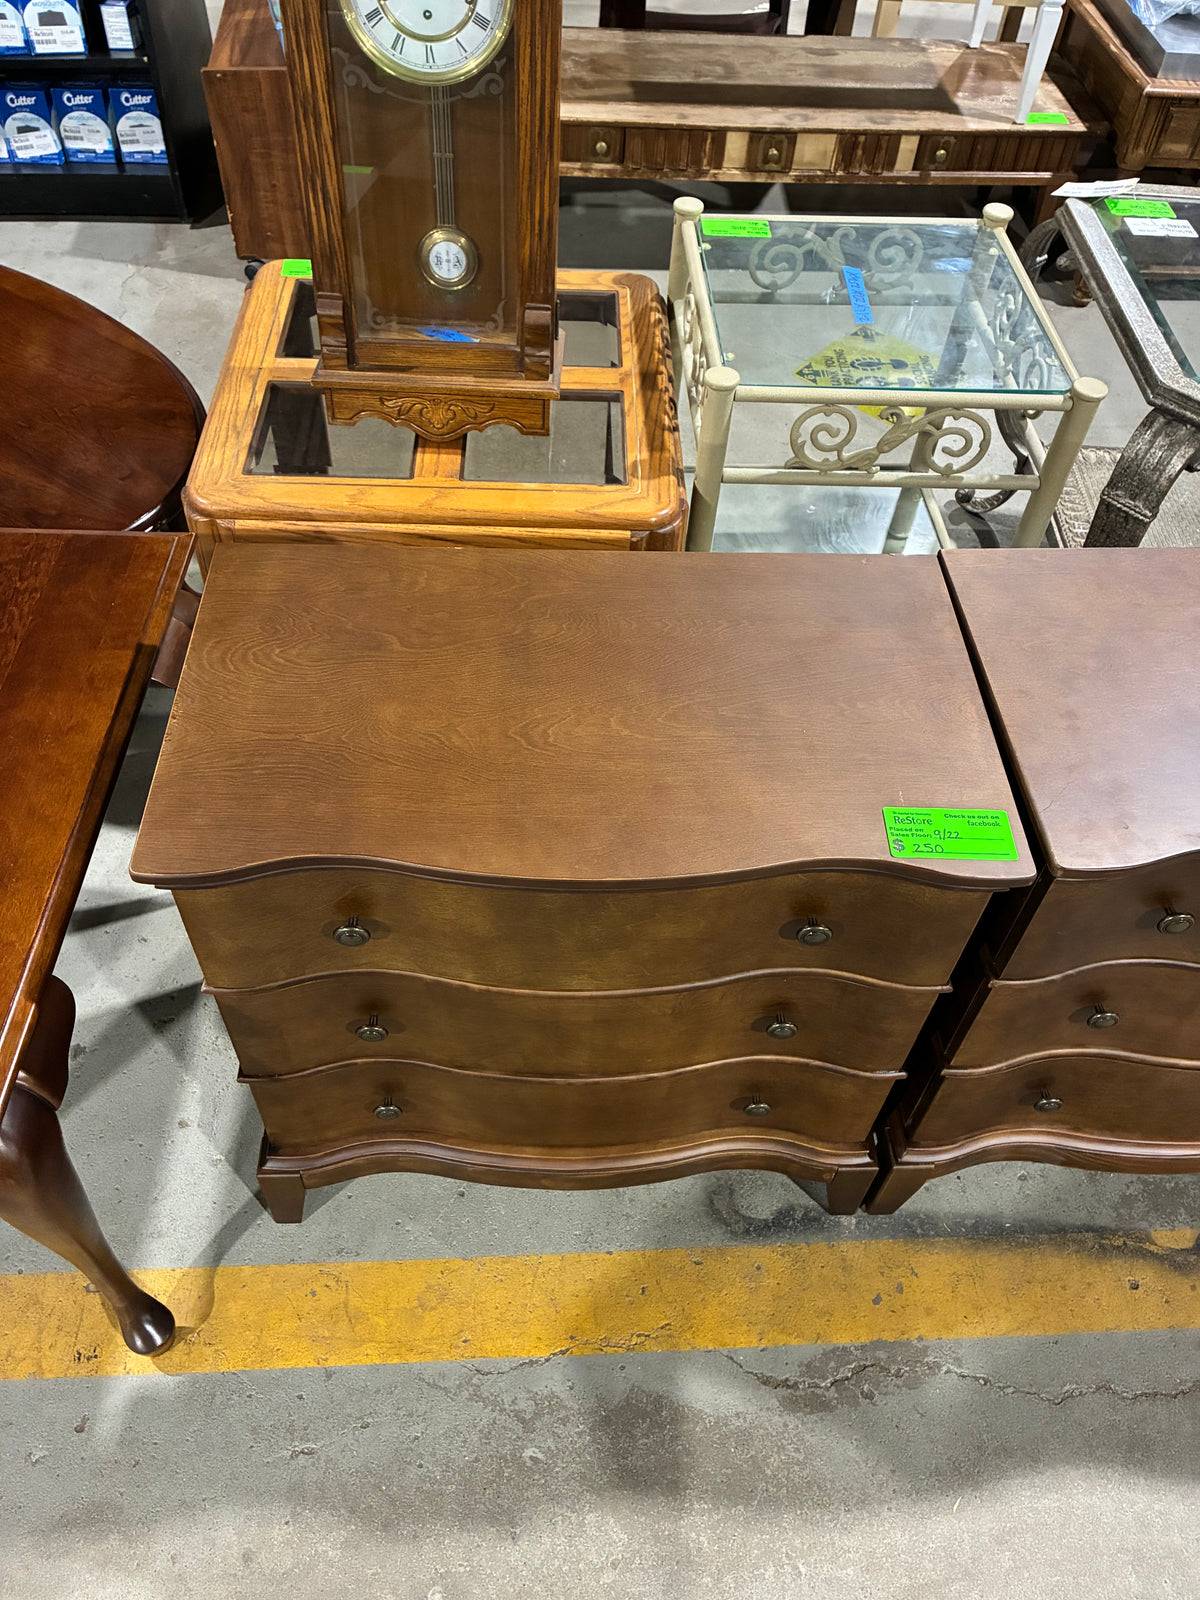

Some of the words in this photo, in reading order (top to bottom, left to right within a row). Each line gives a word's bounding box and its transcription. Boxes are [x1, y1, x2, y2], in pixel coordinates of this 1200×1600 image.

[6, 92, 37, 107] Cutter
[63, 91, 94, 106] Cutter
[121, 91, 152, 106] Cutter
[893, 816, 933, 825] ReStore
[933, 828, 960, 840] 9/22
[892, 838, 906, 852] $
[912, 843, 944, 853] 250
